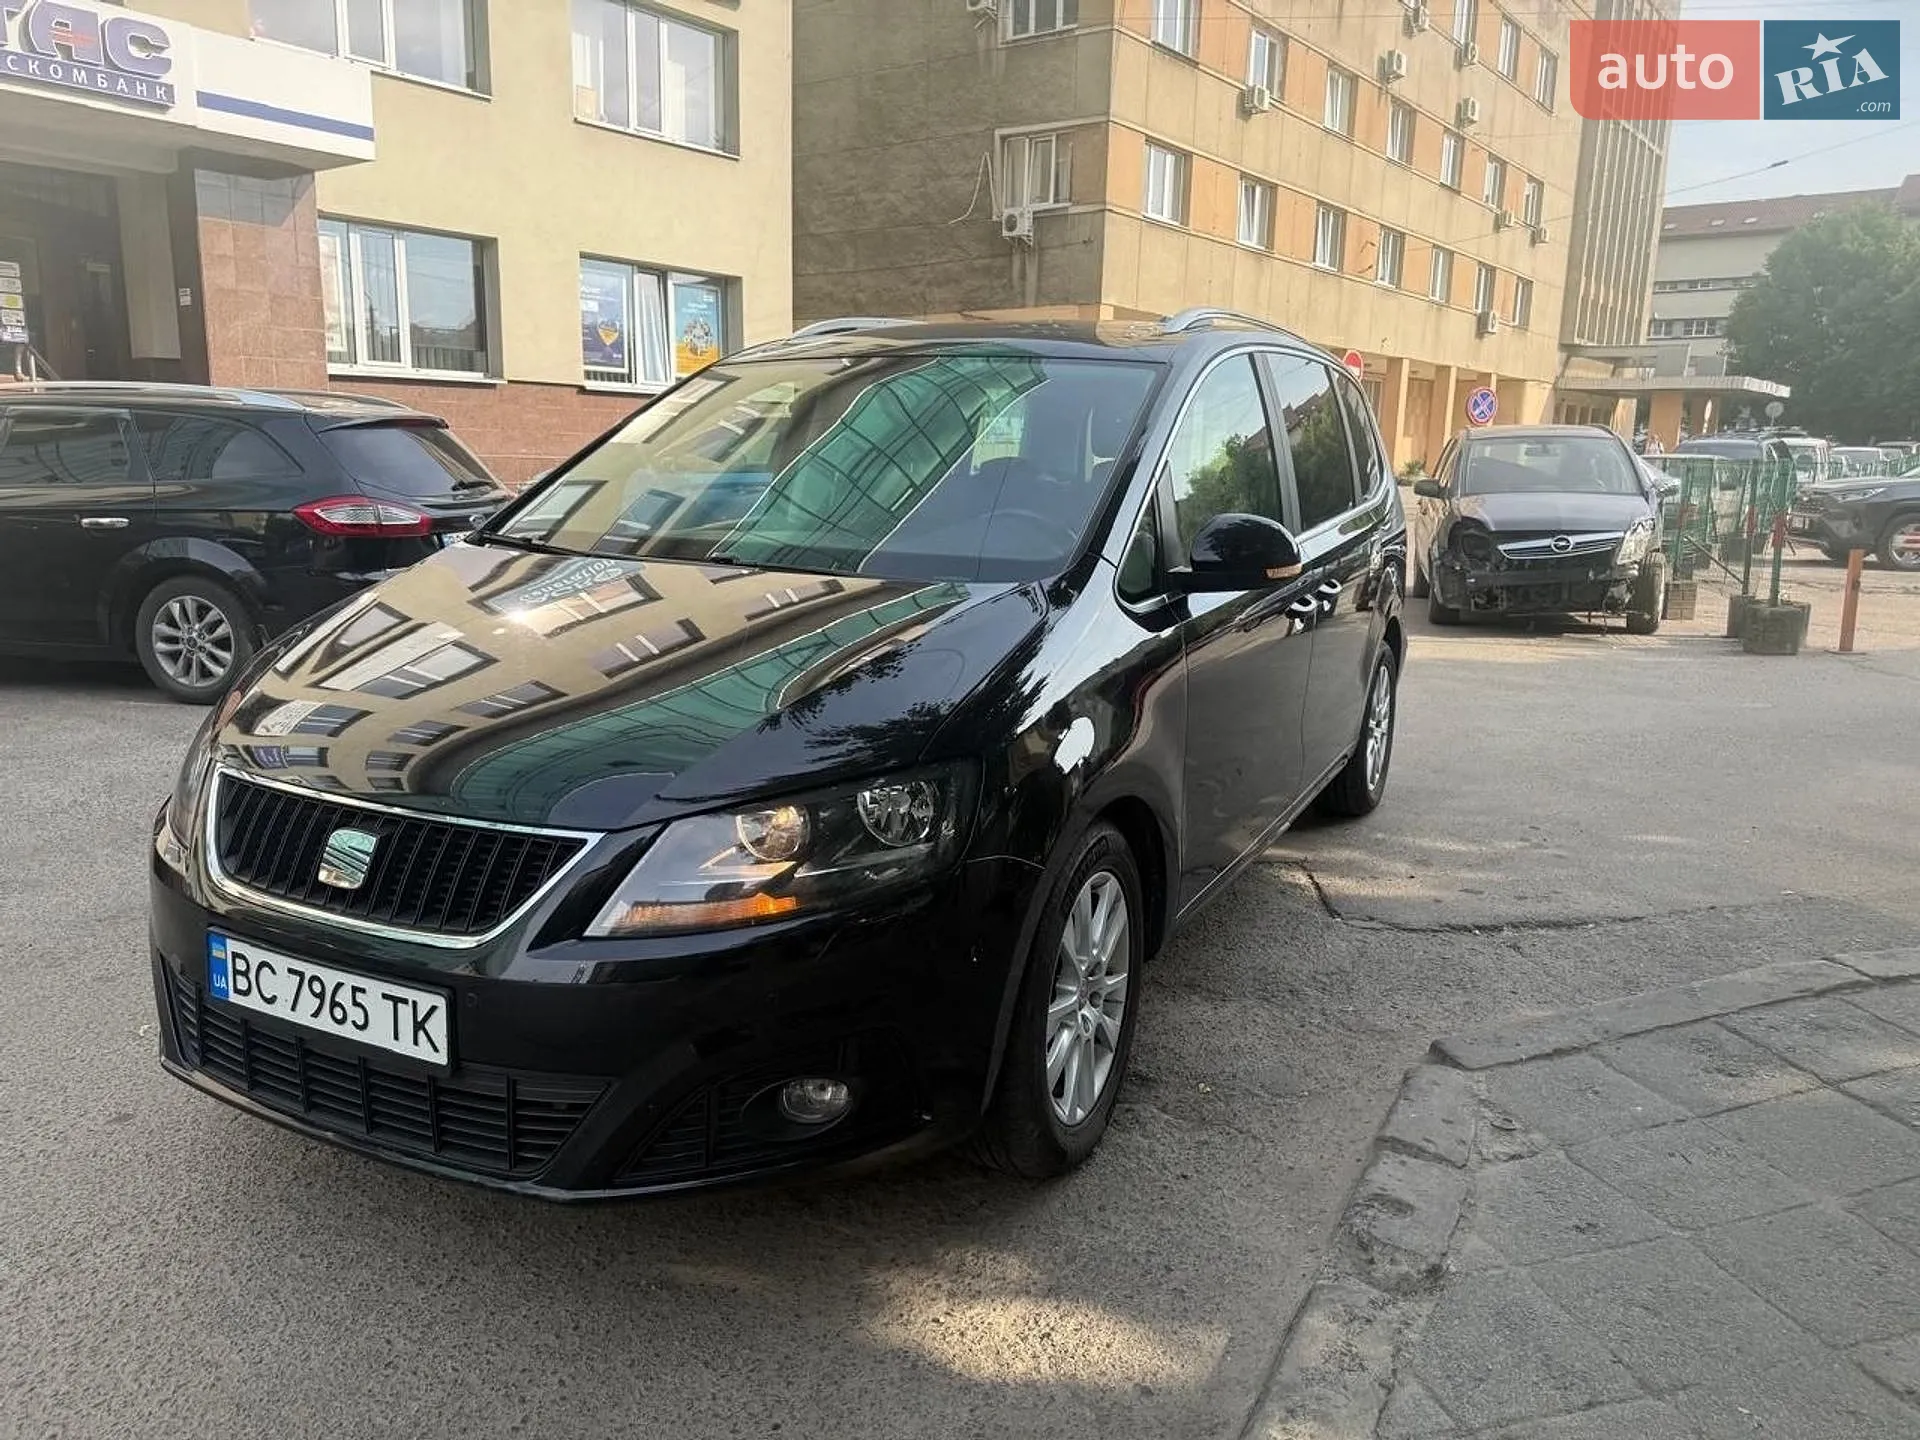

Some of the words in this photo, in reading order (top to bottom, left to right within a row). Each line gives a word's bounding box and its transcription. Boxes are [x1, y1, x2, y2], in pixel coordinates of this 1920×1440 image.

[212, 973, 228, 990] UA
[231, 951, 278, 1005] BC
[286, 967, 370, 1032] 7965
[381, 992, 440, 1053] TK
